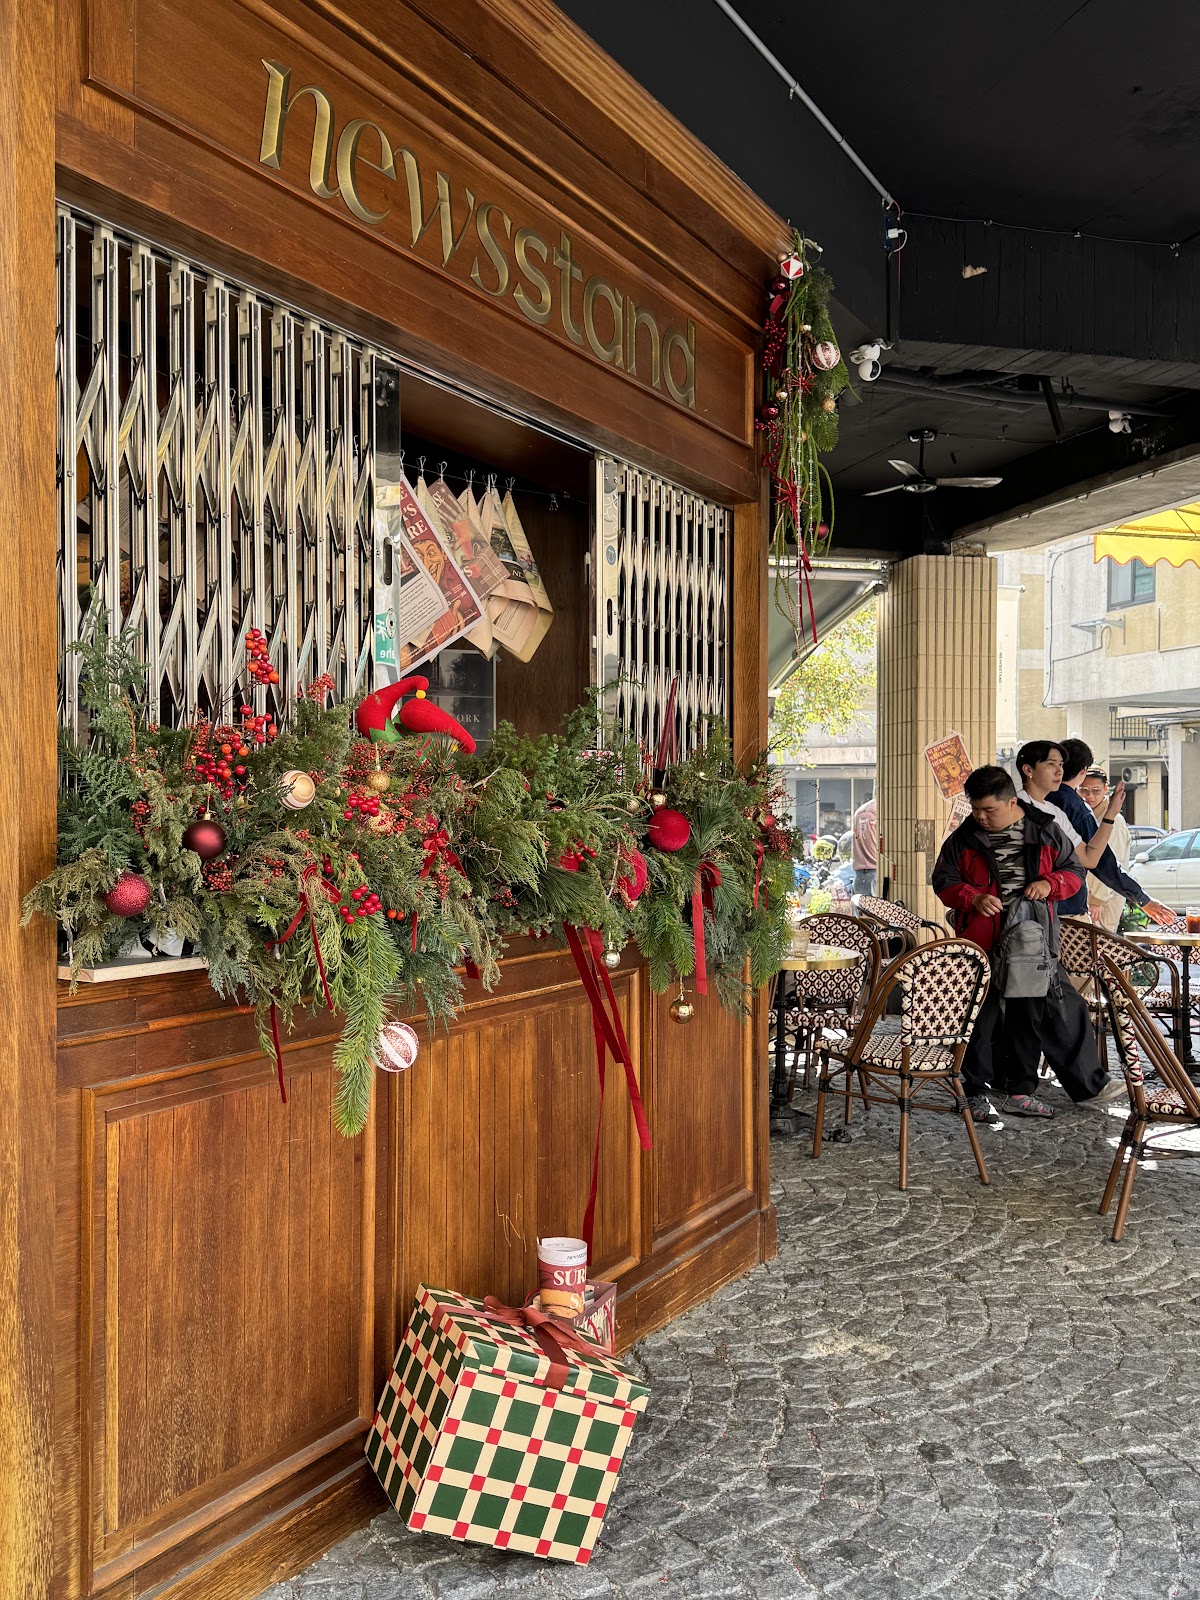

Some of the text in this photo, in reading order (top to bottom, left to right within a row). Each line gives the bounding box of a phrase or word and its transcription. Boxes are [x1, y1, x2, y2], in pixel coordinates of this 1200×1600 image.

[260, 58, 697, 411] newsstand
[456, 714, 480, 723] ORK
[553, 1265, 588, 1287] SUR
